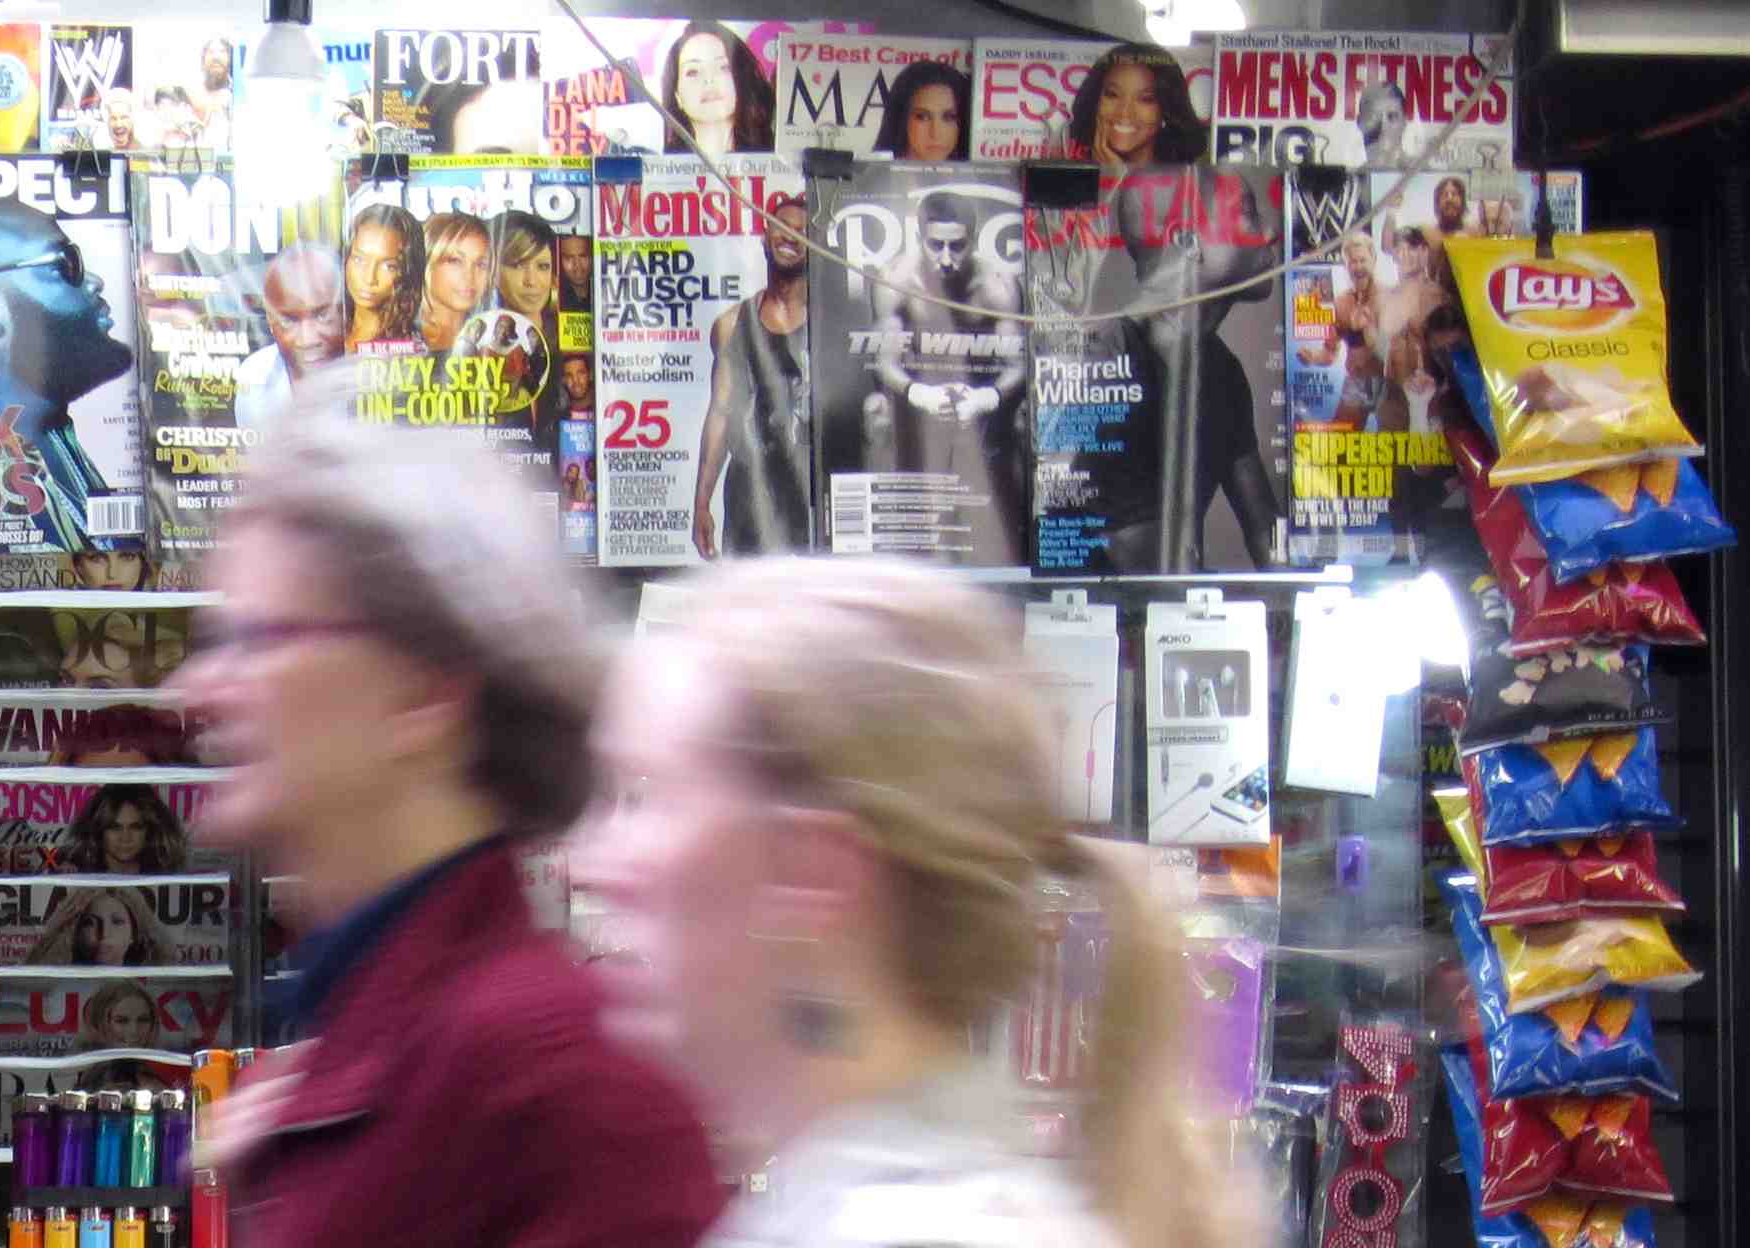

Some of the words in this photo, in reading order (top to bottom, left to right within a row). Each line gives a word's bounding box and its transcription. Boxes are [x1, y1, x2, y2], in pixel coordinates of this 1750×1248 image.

[1340, 36, 1364, 49] The
[1365, 36, 1401, 49] Rock!
[788, 44, 813, 61] 17
[817, 44, 870, 64] Best
[876, 46, 931, 65] Cars
[548, 67, 627, 104] LANA
[1218, 50, 1337, 121] MENS
[600, 250, 695, 277] HARD
[600, 276, 741, 302] MUSCLE
[601, 303, 693, 328] FAST!
[602, 353, 655, 367] Master
[659, 352, 693, 366] Your
[1527, 338, 1630, 360] Classic
[358, 358, 441, 394] CRAZY,
[447, 357, 511, 394] SEXY,
[602, 368, 694, 383] Metabolism
[1035, 355, 1132, 381] Pharrell
[1036, 381, 1143, 404] Williams
[603, 400, 671, 449] 25
[609, 451, 689, 461] SUPERFOODS
[609, 462, 632, 472] FOR
[635, 462, 661, 472] MEN
[1293, 466, 1394, 498] UNITED!
[0, 557, 36, 569] HOW
[39, 557, 56, 569] TO
[0, 569, 76, 588] STAND
